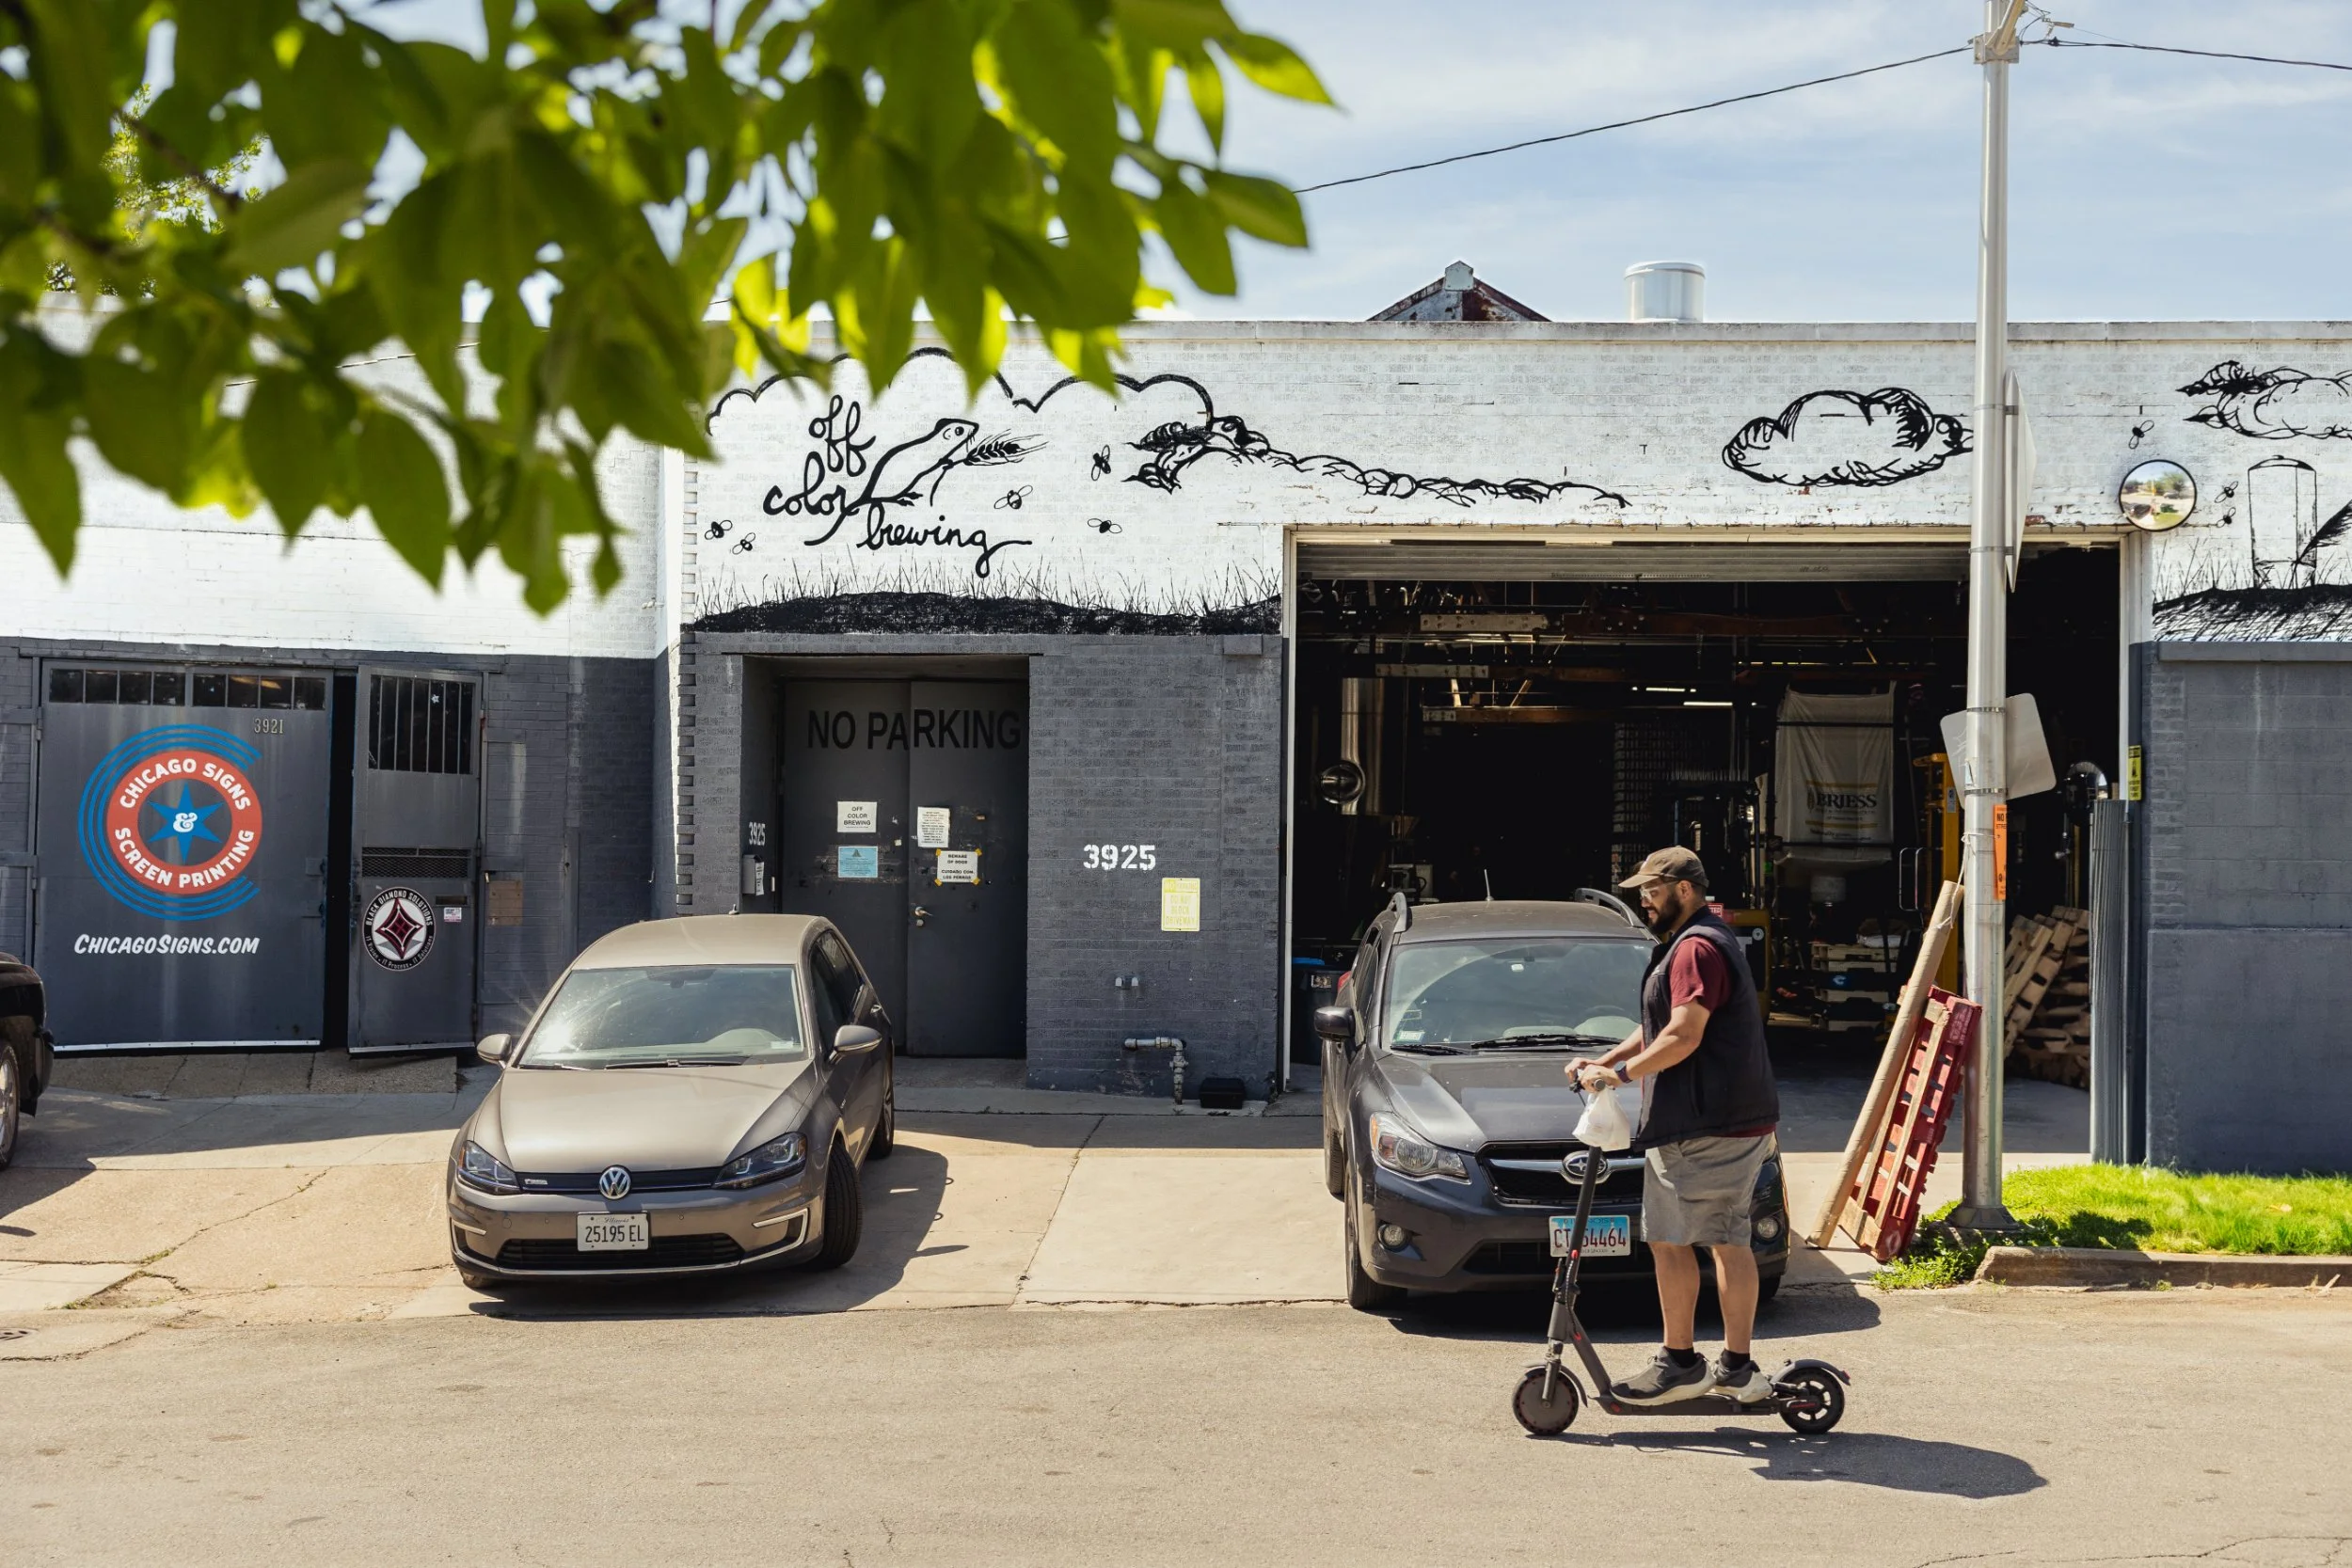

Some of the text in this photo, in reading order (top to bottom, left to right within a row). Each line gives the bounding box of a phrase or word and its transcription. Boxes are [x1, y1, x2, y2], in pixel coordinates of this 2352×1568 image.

[808, 394, 877, 477] off
[762, 451, 848, 516] color
[856, 501, 1033, 578] brewing
[254, 718, 283, 734] 3921
[807, 708, 1022, 751] NO PARKING
[119, 758, 251, 810] CHICAGO SIGNS
[1817, 793, 1877, 809] BRIESS
[173, 812, 198, 832] &
[1996, 813, 2005, 822] NO
[749, 821, 766, 846] 3925
[115, 827, 255, 888] SCREEN PRINTING
[1083, 844, 1156, 871] 3925
[365, 903, 380, 926] BLACK
[378, 890, 407, 904] DIAMOND
[407, 893, 434, 927] SOLUTIONS
[585, 1225, 645, 1243] 25195 EL
[1554, 1228, 1571, 1248] CT
